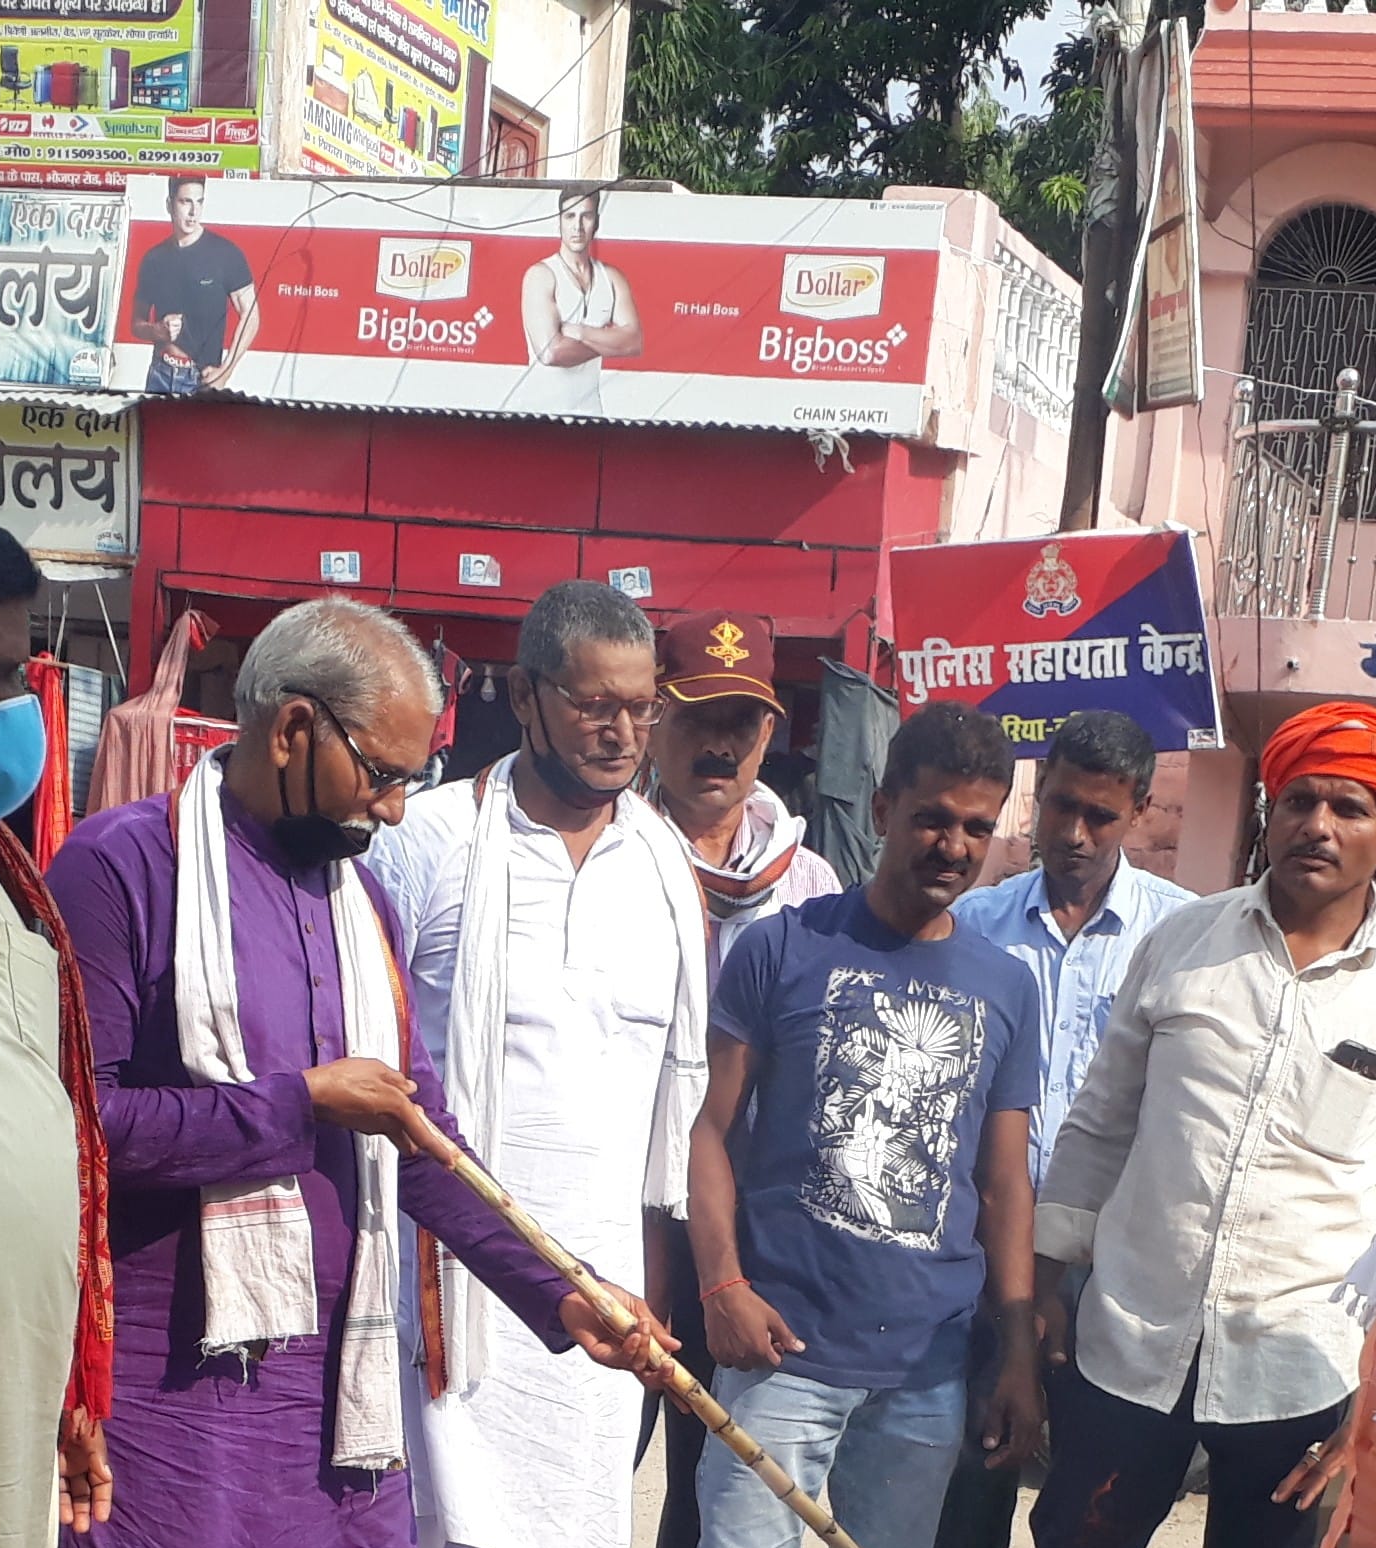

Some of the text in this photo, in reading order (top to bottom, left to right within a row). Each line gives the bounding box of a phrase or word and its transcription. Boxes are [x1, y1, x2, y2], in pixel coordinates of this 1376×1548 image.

[138, 150, 221, 165] 8299149307
[11, 200, 122, 240] एक दाम
[390, 252, 455, 280] Dollar
[278, 284, 339, 298] Fit Hai Boss
[795, 269, 868, 298] Dollar
[674, 301, 740, 317] Fit Hai Boss
[357, 306, 478, 352] Bigboss
[758, 324, 890, 374] Bigboss
[21, 404, 68, 434] एक
[793, 406, 889, 424] CHAIN SHAKTI
[898, 622, 1205, 704] पुलिस सहायता केन्द्र
